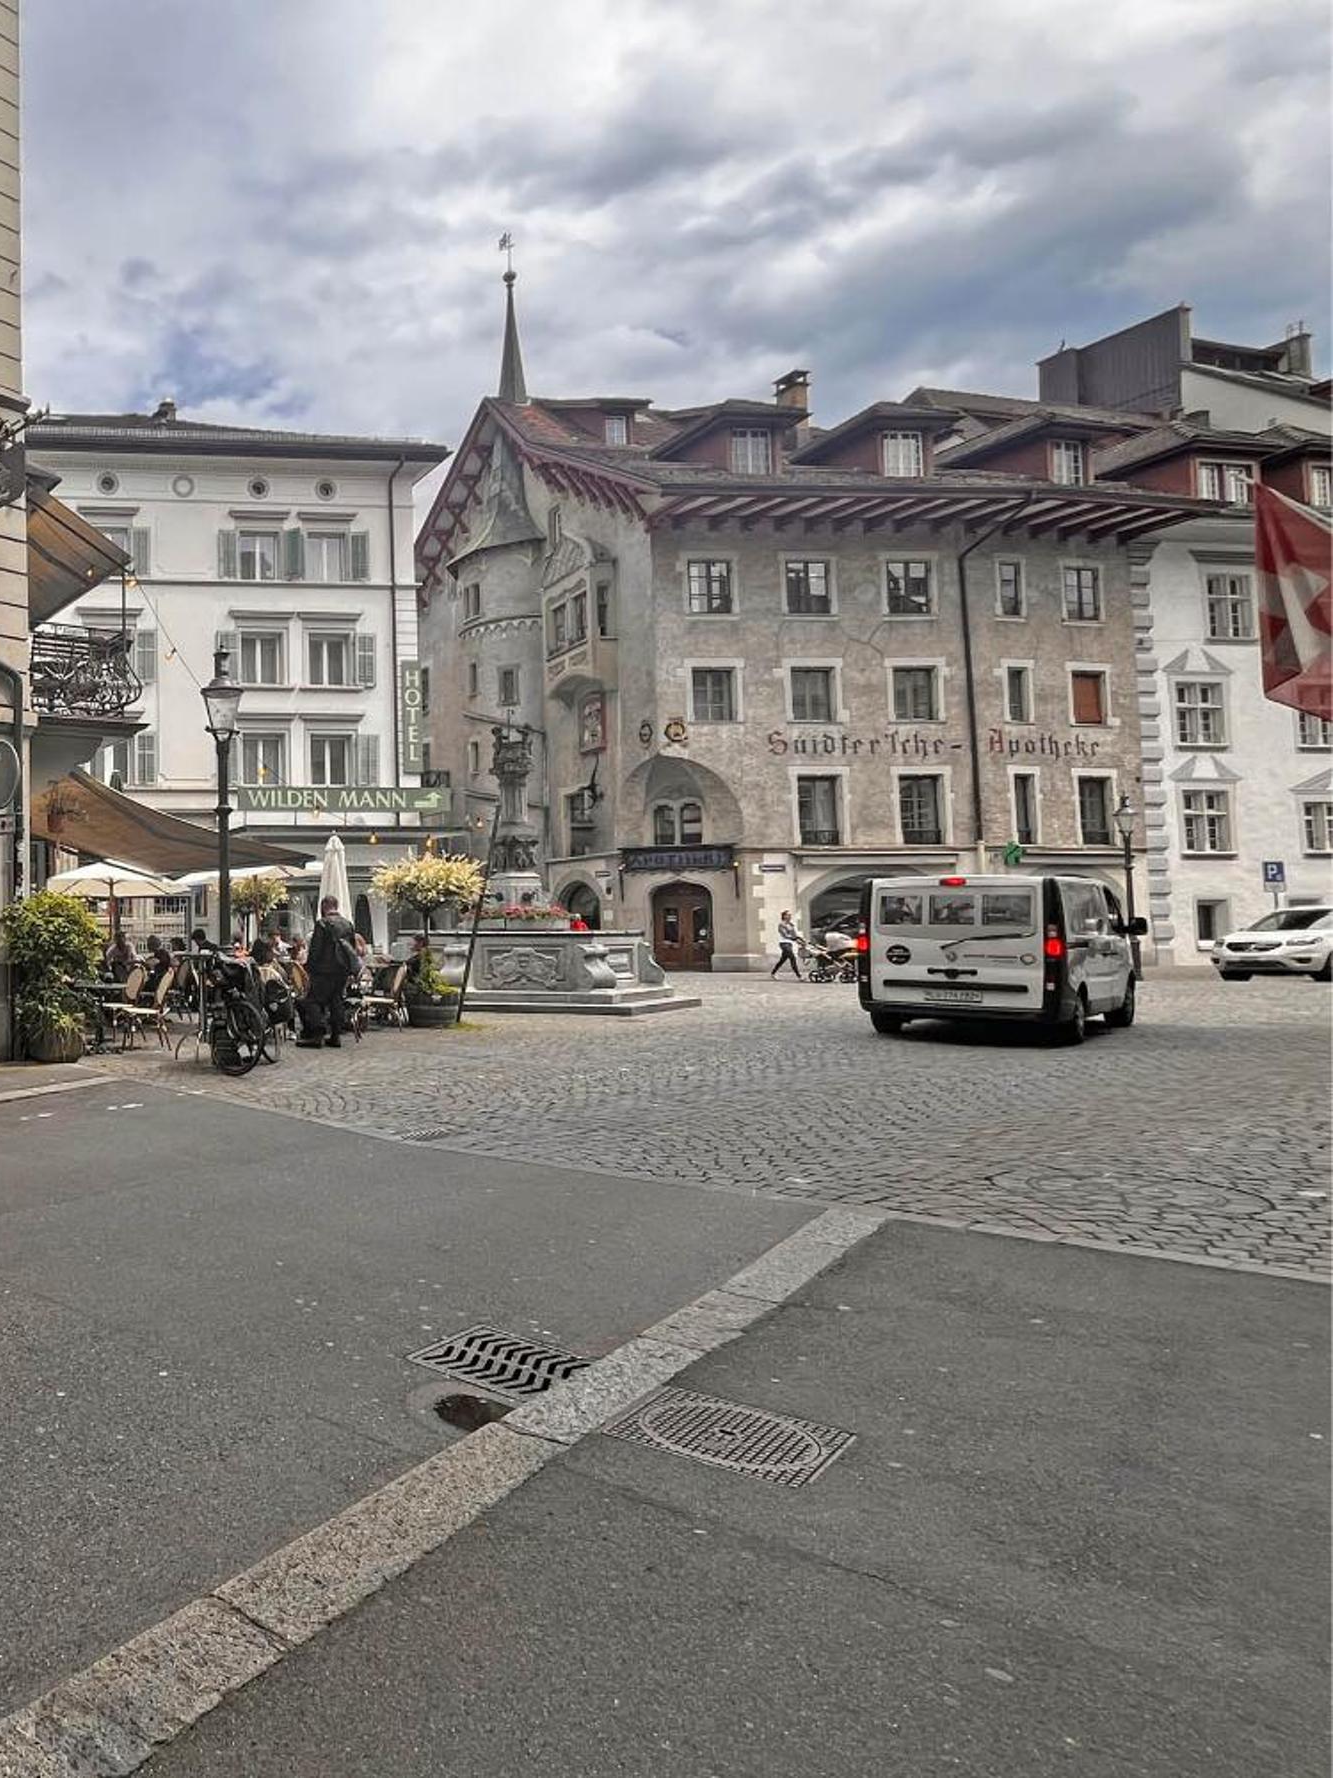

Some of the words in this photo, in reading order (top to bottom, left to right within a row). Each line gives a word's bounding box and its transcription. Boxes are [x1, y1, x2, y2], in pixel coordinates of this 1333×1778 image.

[404, 669, 421, 762] HOTEL
[988, 728, 1100, 760] Apotheke
[248, 789, 329, 808] WILDEN
[338, 789, 407, 808] MANN
[1267, 864, 1278, 880] P
